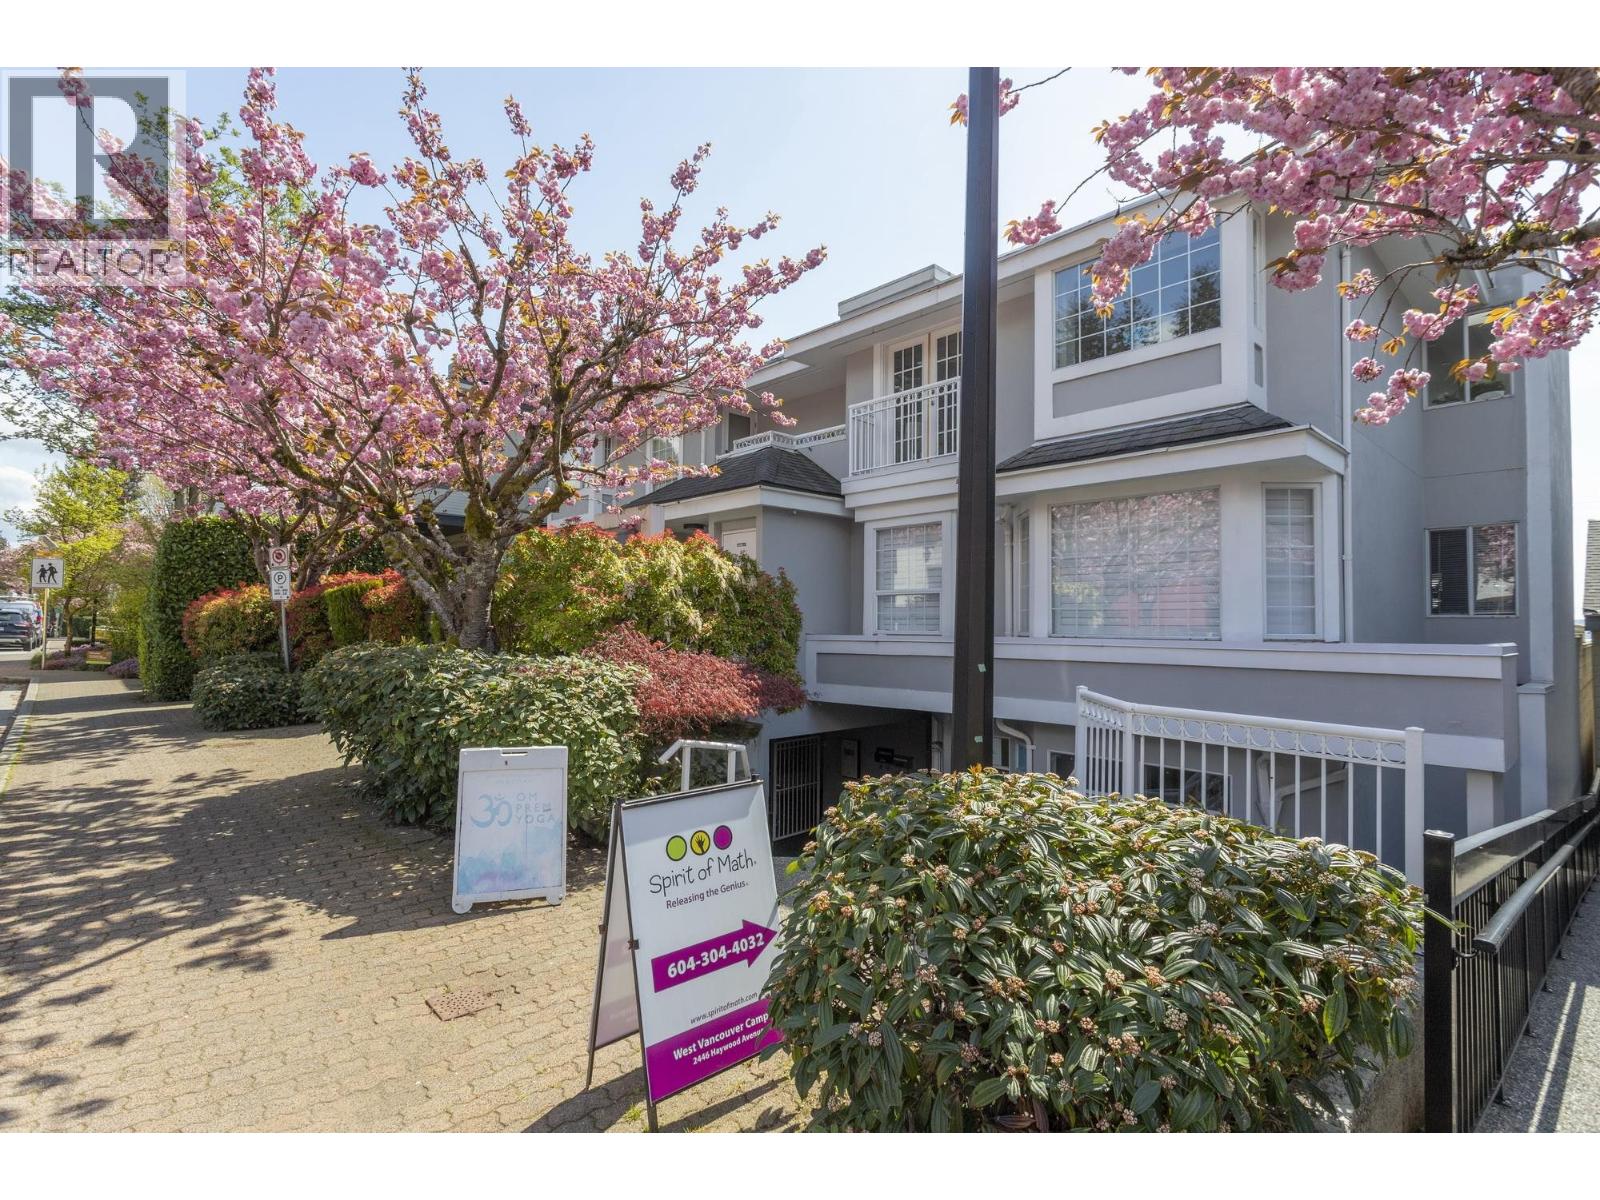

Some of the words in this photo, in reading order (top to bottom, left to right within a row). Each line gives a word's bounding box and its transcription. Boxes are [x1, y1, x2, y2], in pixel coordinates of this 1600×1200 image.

[517, 792, 537, 801] OM
[515, 814, 555, 824] YOGA
[649, 866, 695, 897] Spirit
[697, 857, 714, 880] of
[666, 892, 705, 909] Releasing
[706, 887, 719, 898] the
[667, 932, 765, 978] 604-304-4032
[690, 992, 758, 1024] www.spiritofmath.com
[673, 1043, 697, 1060] West
[697, 1023, 744, 1049] Vancouver
[693, 1052, 710, 1065] 2446
[711, 1039, 741, 1057] Haywood
